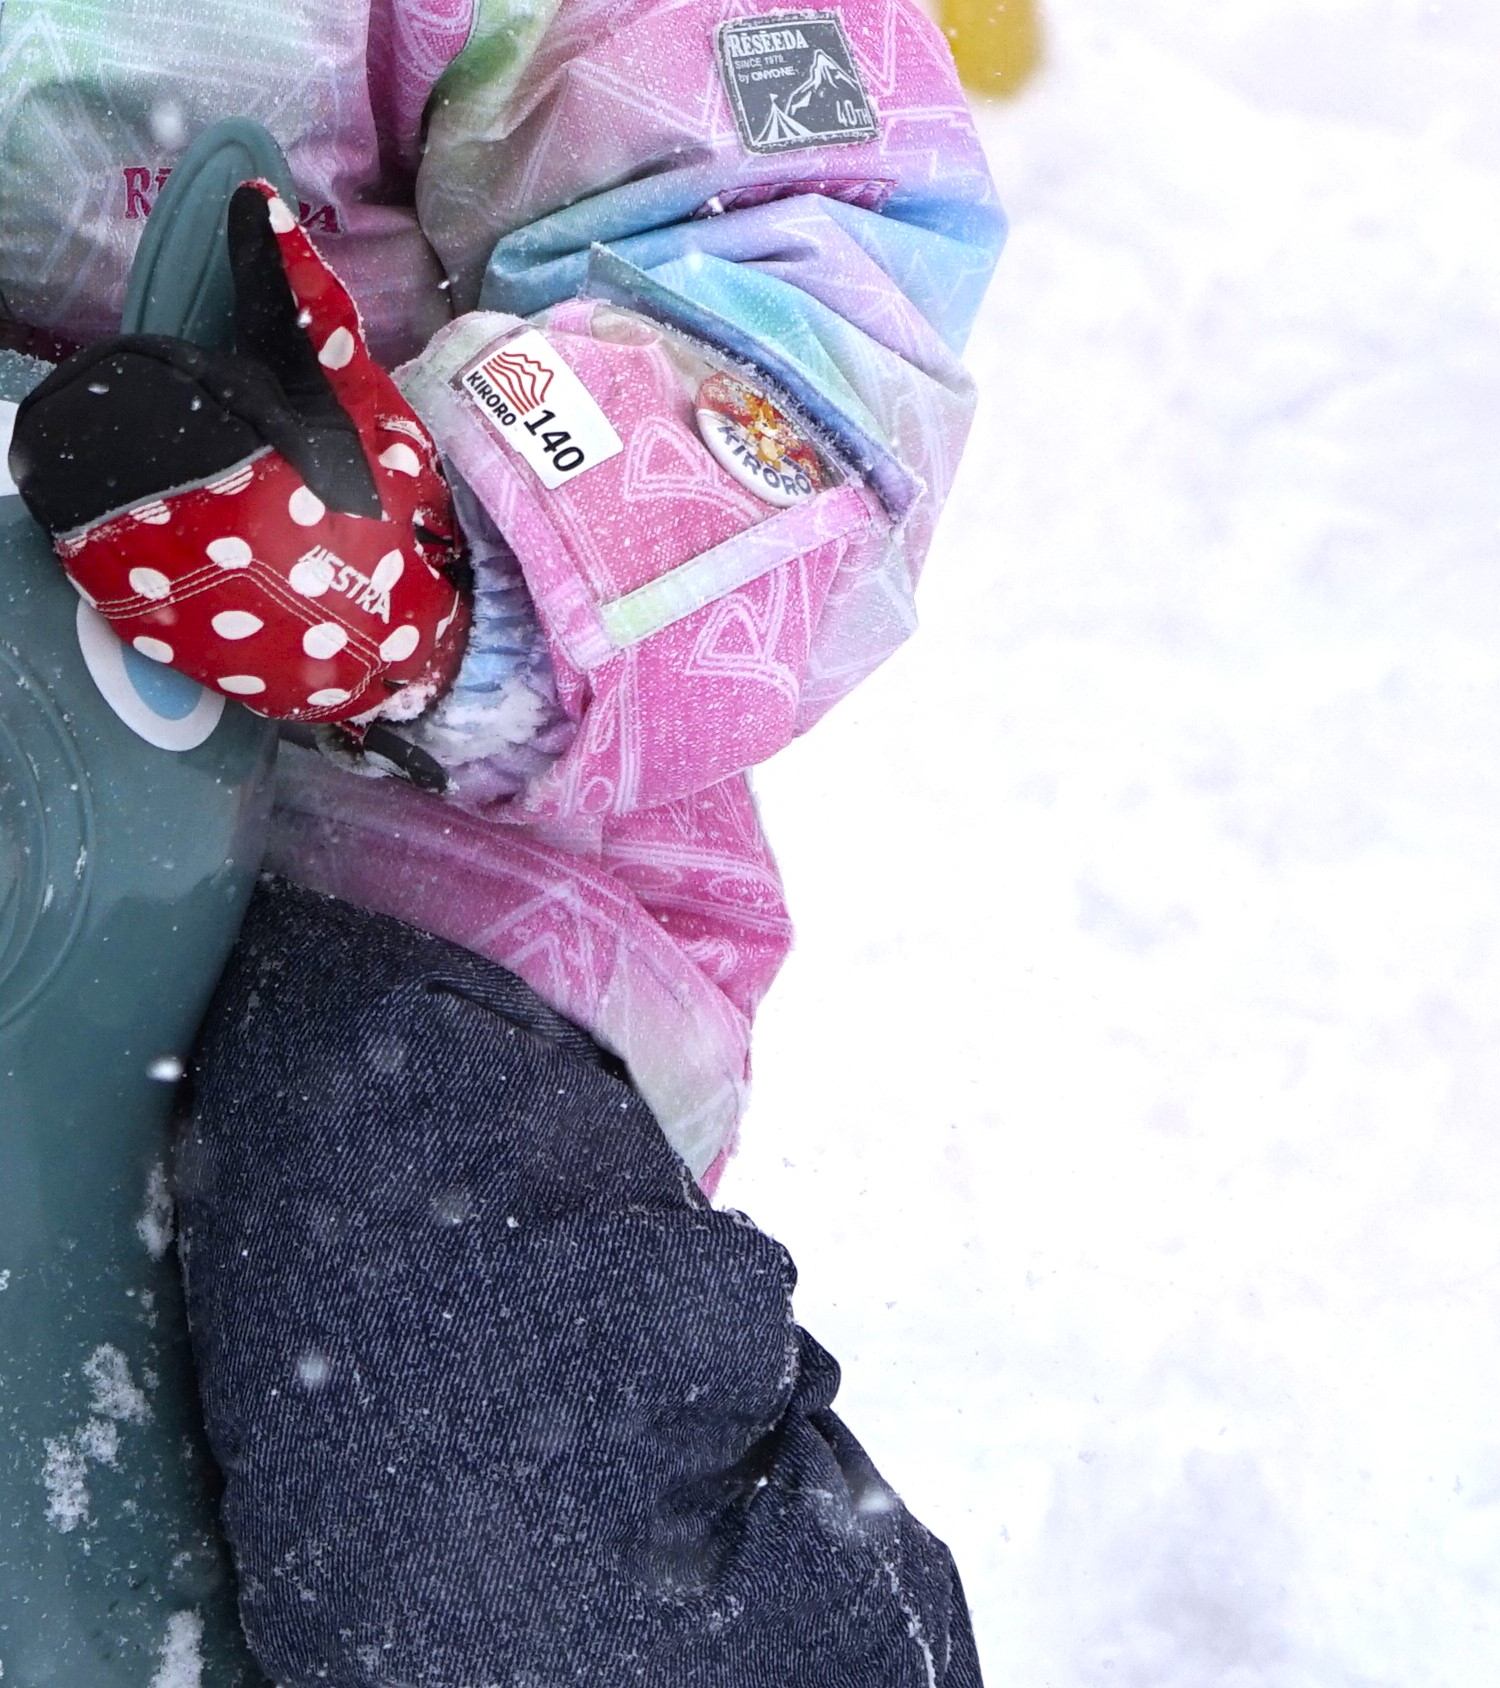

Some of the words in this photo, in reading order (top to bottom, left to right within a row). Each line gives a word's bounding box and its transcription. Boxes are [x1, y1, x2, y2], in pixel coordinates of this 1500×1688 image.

[738, 72, 750, 84] by
[466, 370, 518, 427] KIRORO
[523, 408, 586, 473] 140
[717, 425, 812, 496] KIRORO
